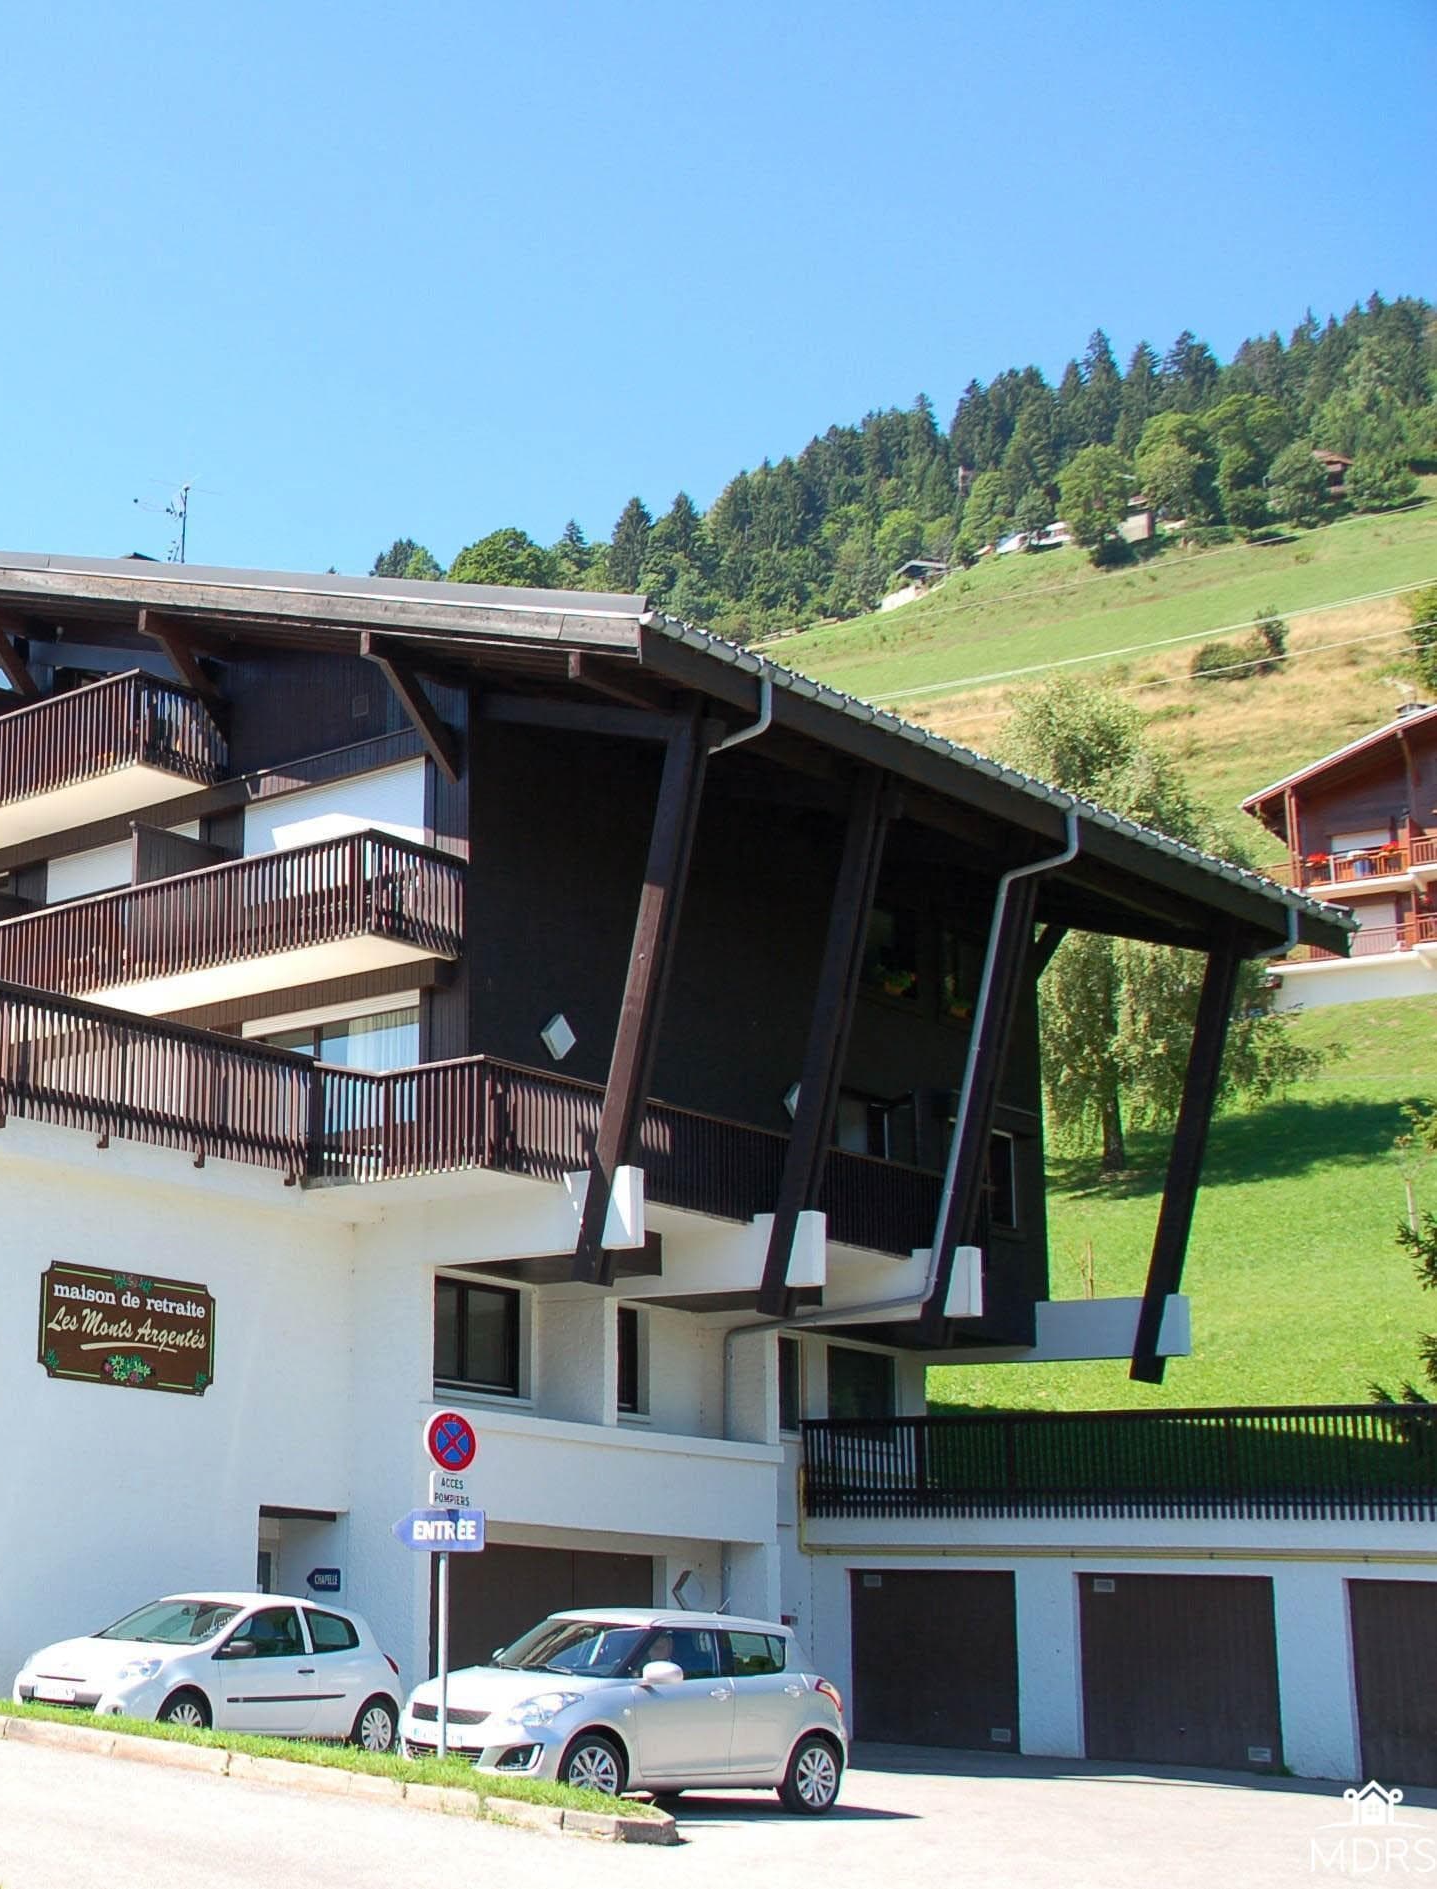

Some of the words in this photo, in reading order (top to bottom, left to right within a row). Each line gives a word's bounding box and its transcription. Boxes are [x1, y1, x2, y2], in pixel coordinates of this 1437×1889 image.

[53, 1283, 117, 1305] maison
[121, 1291, 141, 1309] de
[145, 1298, 206, 1319] retraite
[47, 1304, 79, 1332] Les
[81, 1307, 133, 1338] Monts
[134, 1318, 207, 1352] Argentés
[434, 1492, 470, 1506] POMPIERS
[413, 1518, 476, 1541] ENTRÉE
